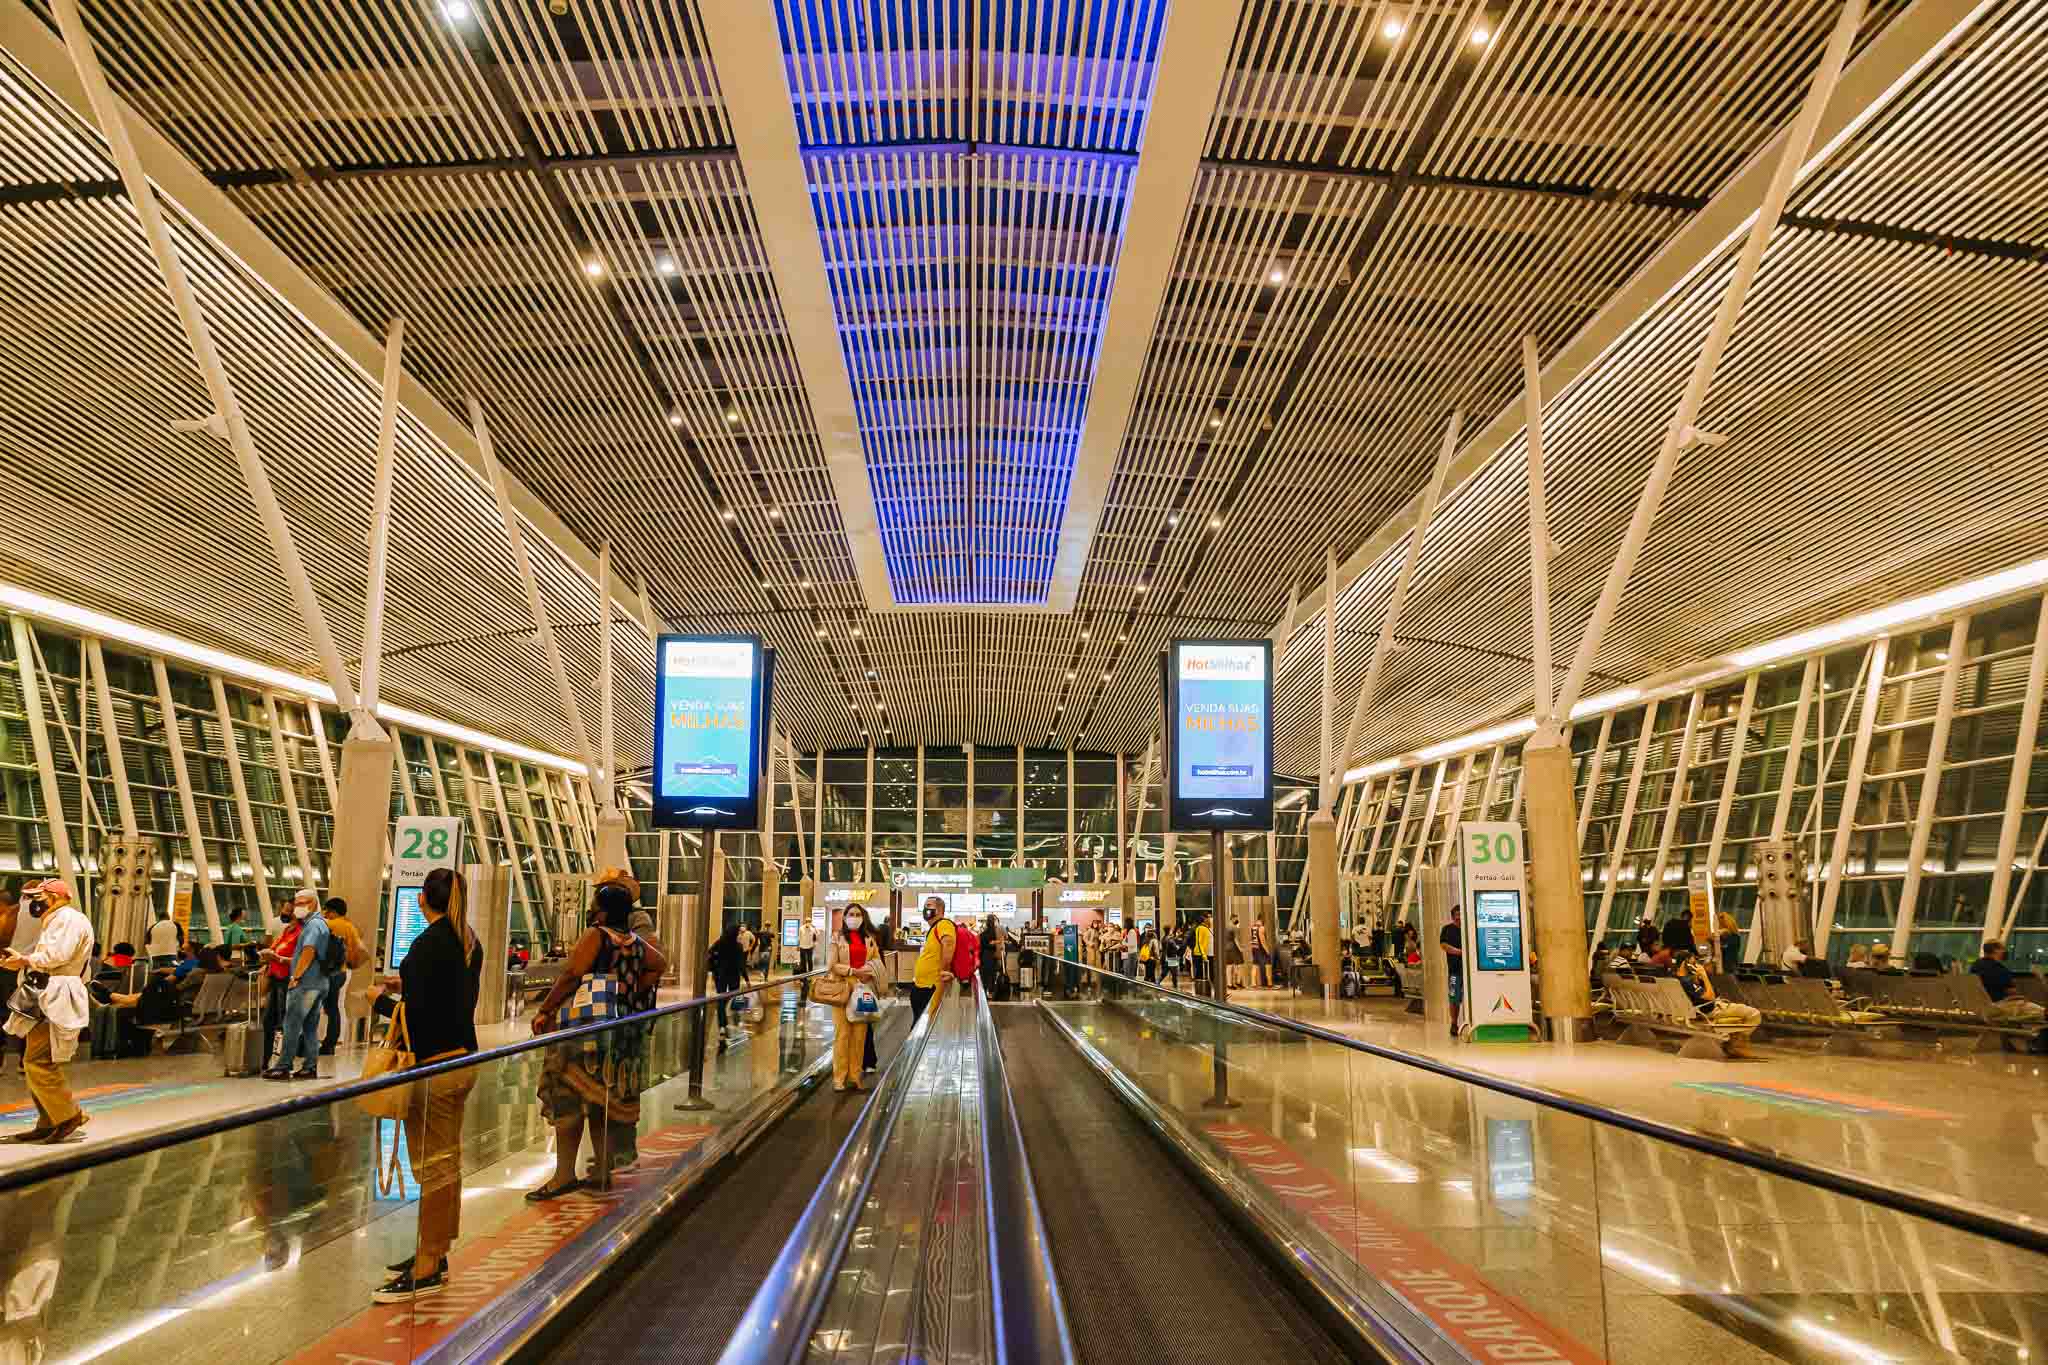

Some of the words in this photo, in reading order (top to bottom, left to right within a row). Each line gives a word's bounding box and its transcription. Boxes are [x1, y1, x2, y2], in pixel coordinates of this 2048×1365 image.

[1184, 703, 1226, 712] VENDA
[1228, 703, 1259, 712] SUAS
[671, 712, 745, 728] MILHAS
[1186, 714, 1260, 732] MILHAS
[401, 828, 449, 859] 28
[1471, 833, 1516, 864] 30
[784, 900, 800, 912] 31
[1136, 900, 1153, 911] 32
